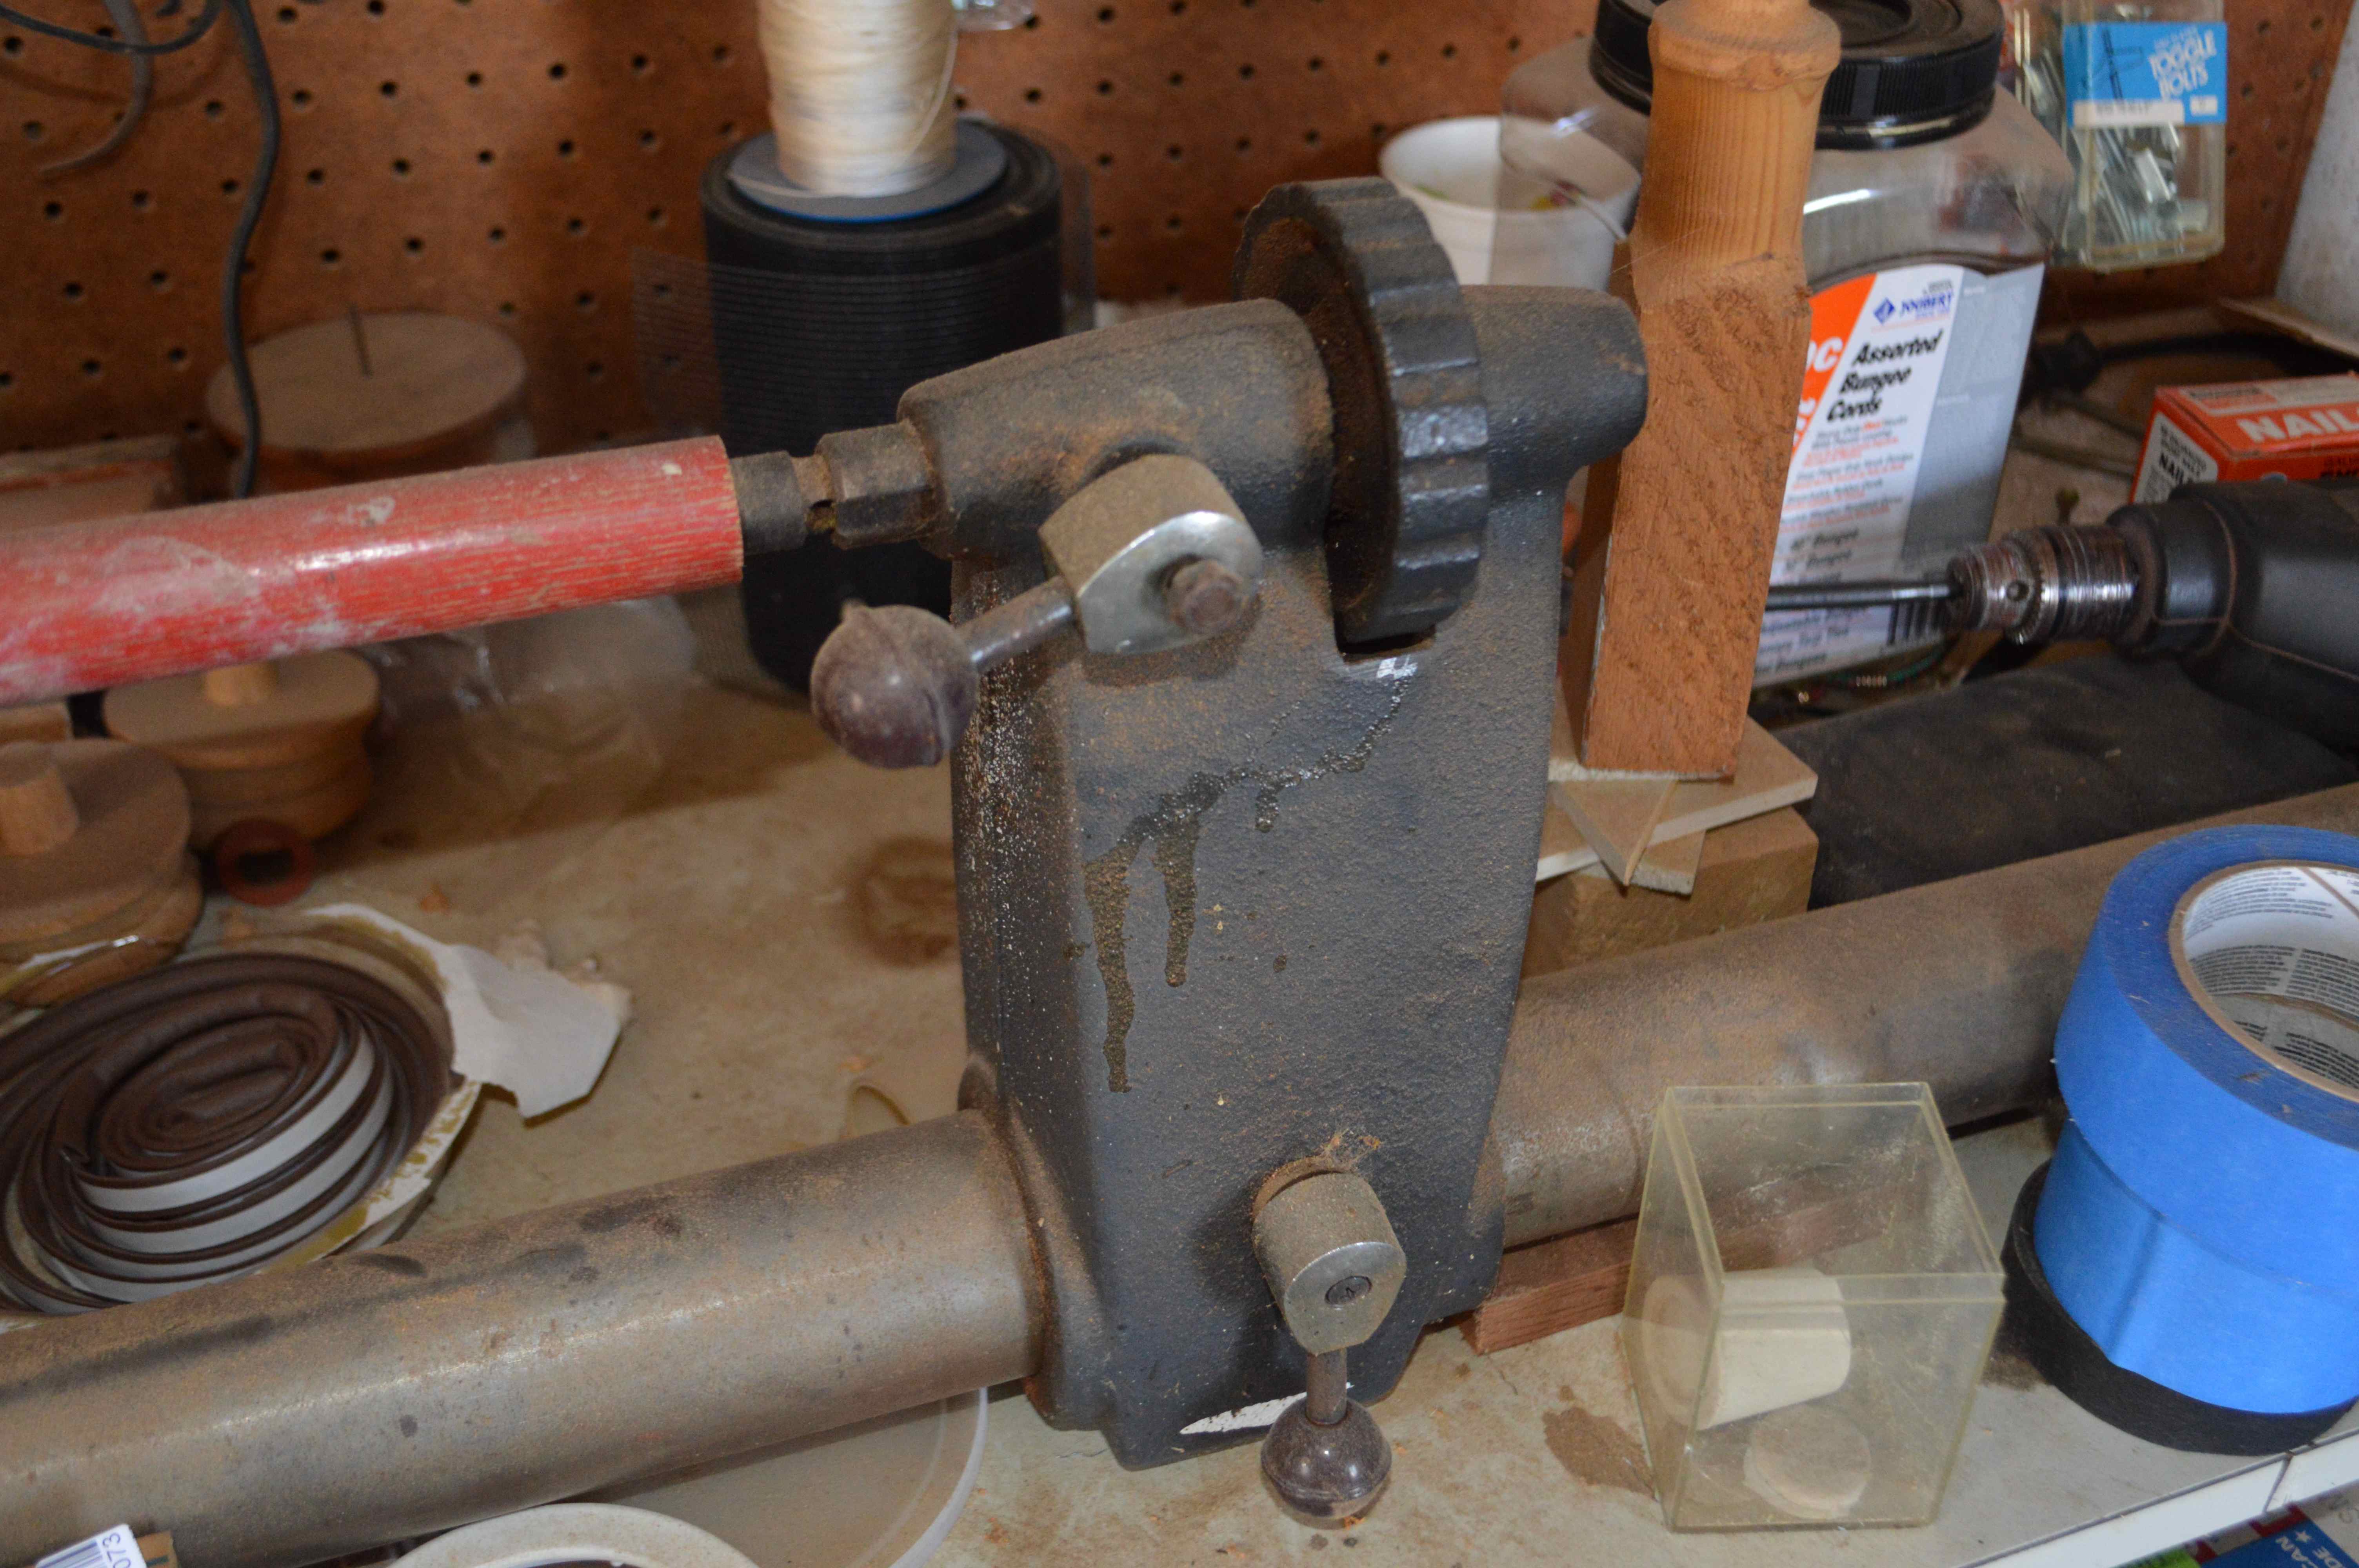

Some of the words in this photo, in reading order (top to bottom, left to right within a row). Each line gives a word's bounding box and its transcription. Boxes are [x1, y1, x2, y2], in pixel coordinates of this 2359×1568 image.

[2149, 29, 2217, 81] TOGGLE
[1852, 329, 1944, 366] Assorted
[1839, 367, 1913, 395] Bungee
[1827, 391, 1882, 423] Cords
[2237, 405, 2359, 443] NAIL
